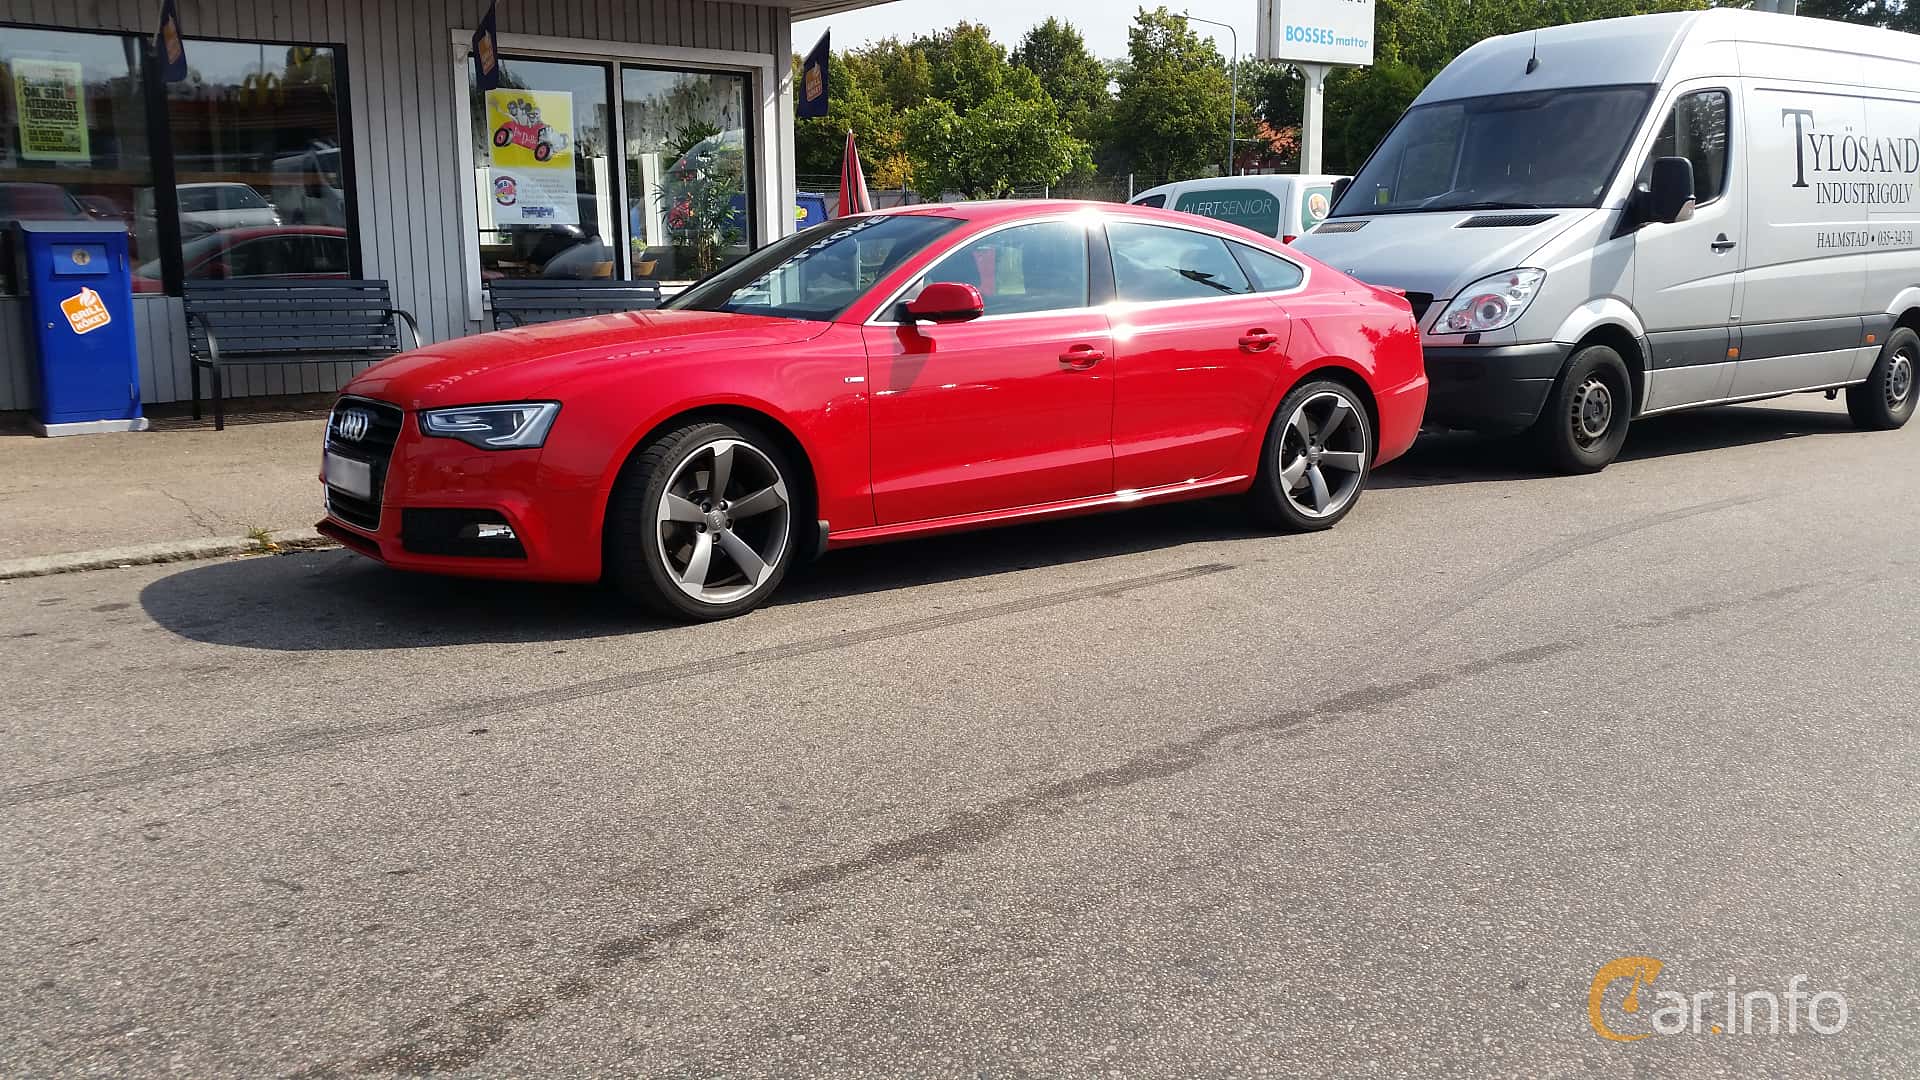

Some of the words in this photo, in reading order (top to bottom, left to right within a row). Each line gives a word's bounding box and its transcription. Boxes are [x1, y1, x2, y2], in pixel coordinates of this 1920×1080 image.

[1286, 25, 1334, 45] BOSSES
[1336, 36, 1369, 48] mattor
[1816, 182, 1913, 204] INDUSTRIGOLV
[1817, 231, 1869, 248] HALMSTAD
